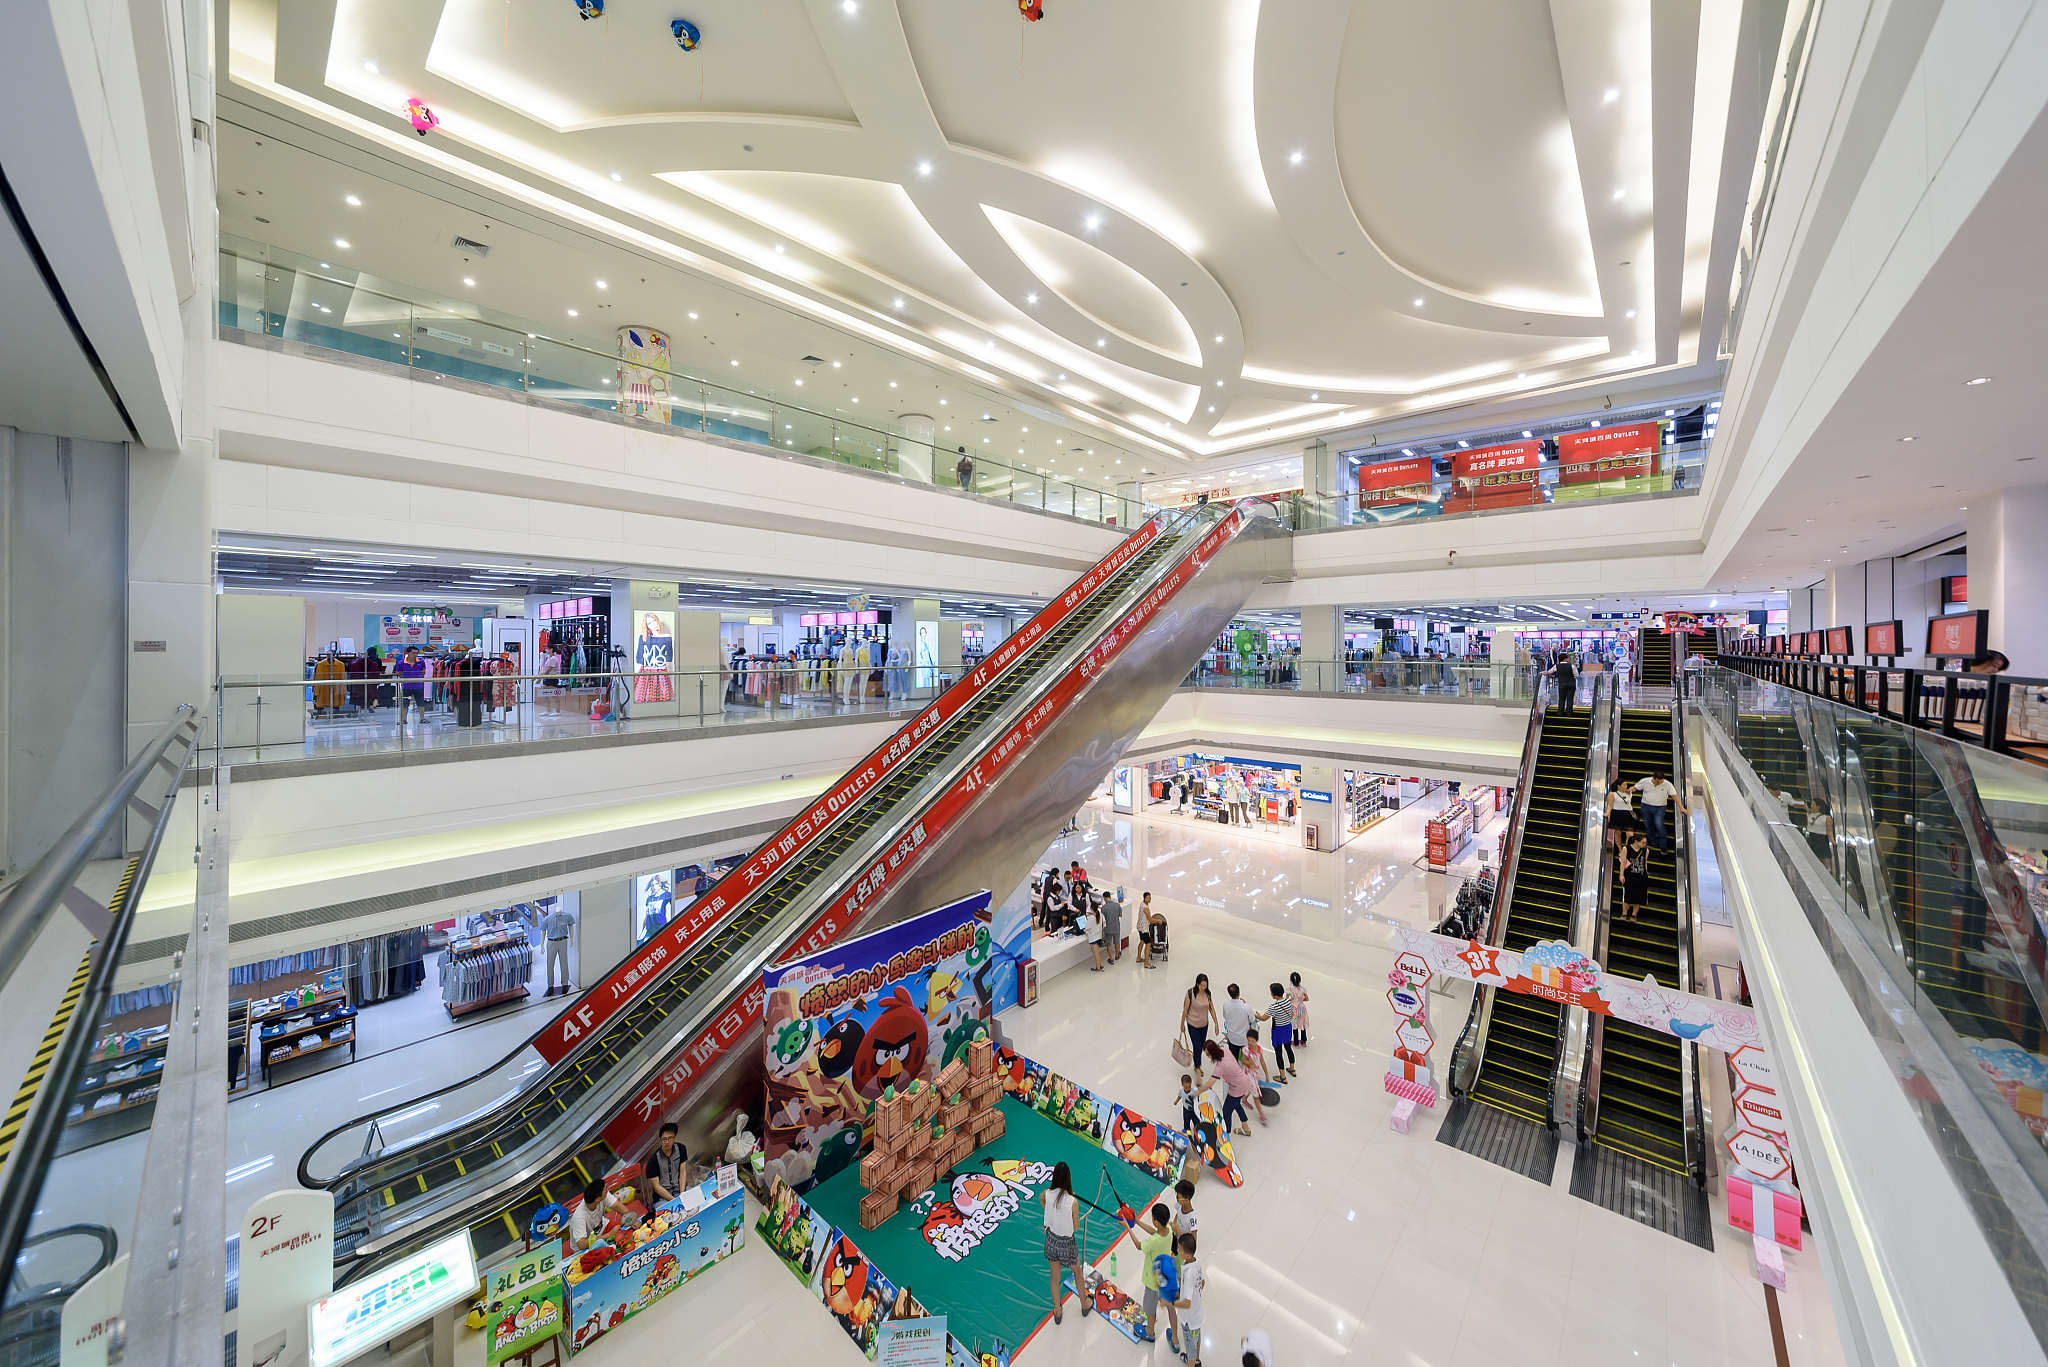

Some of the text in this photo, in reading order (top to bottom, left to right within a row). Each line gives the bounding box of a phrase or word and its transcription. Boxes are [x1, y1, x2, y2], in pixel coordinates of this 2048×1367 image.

[1469, 455, 1525, 471] 真名牌 更实惠
[1130, 531, 1150, 552] OUTLETS
[1191, 550, 1201, 566] 4F
[1157, 573, 1180, 600] OUTLETS
[643, 644, 667, 657] MY
[972, 622, 1043, 688] 4F 儿童服饰 床上用品
[965, 699, 1054, 792] 4F 儿童服饰 床上用品
[741, 707, 941, 885] 天河城百货 OUTLETS 真名牌 更实惠
[1307, 792, 1330, 801] Columbia
[562, 895, 727, 1043] 4F 儿童服饰 床上用品
[633, 985, 764, 1122] 天河城百货
[844, 861, 886, 917] 真名牌
[887, 820, 928, 869] 更实惠
[799, 921, 976, 1019] 愤怒的小鸟激斗弹射
[1467, 951, 1491, 971] 3F
[804, 968, 830, 984] OUTLETS
[1532, 984, 1581, 1006] 时尚女王
[1738, 1059, 1748, 1067] La
[1744, 1101, 1779, 1117] Triumph
[1735, 1142, 1749, 1154] LA
[1751, 1149, 1781, 1165] IDÉE
[250, 1214, 282, 1239] 2F
[290, 1233, 322, 1250] OUTLETS
[619, 1221, 701, 1279] 愤怒的小鸟
[493, 1254, 556, 1298] 礼品区
[494, 1326, 528, 1353] ANGRY
[529, 1311, 558, 1335] BIRDS
[891, 1328, 931, 1340] 游戏规则
